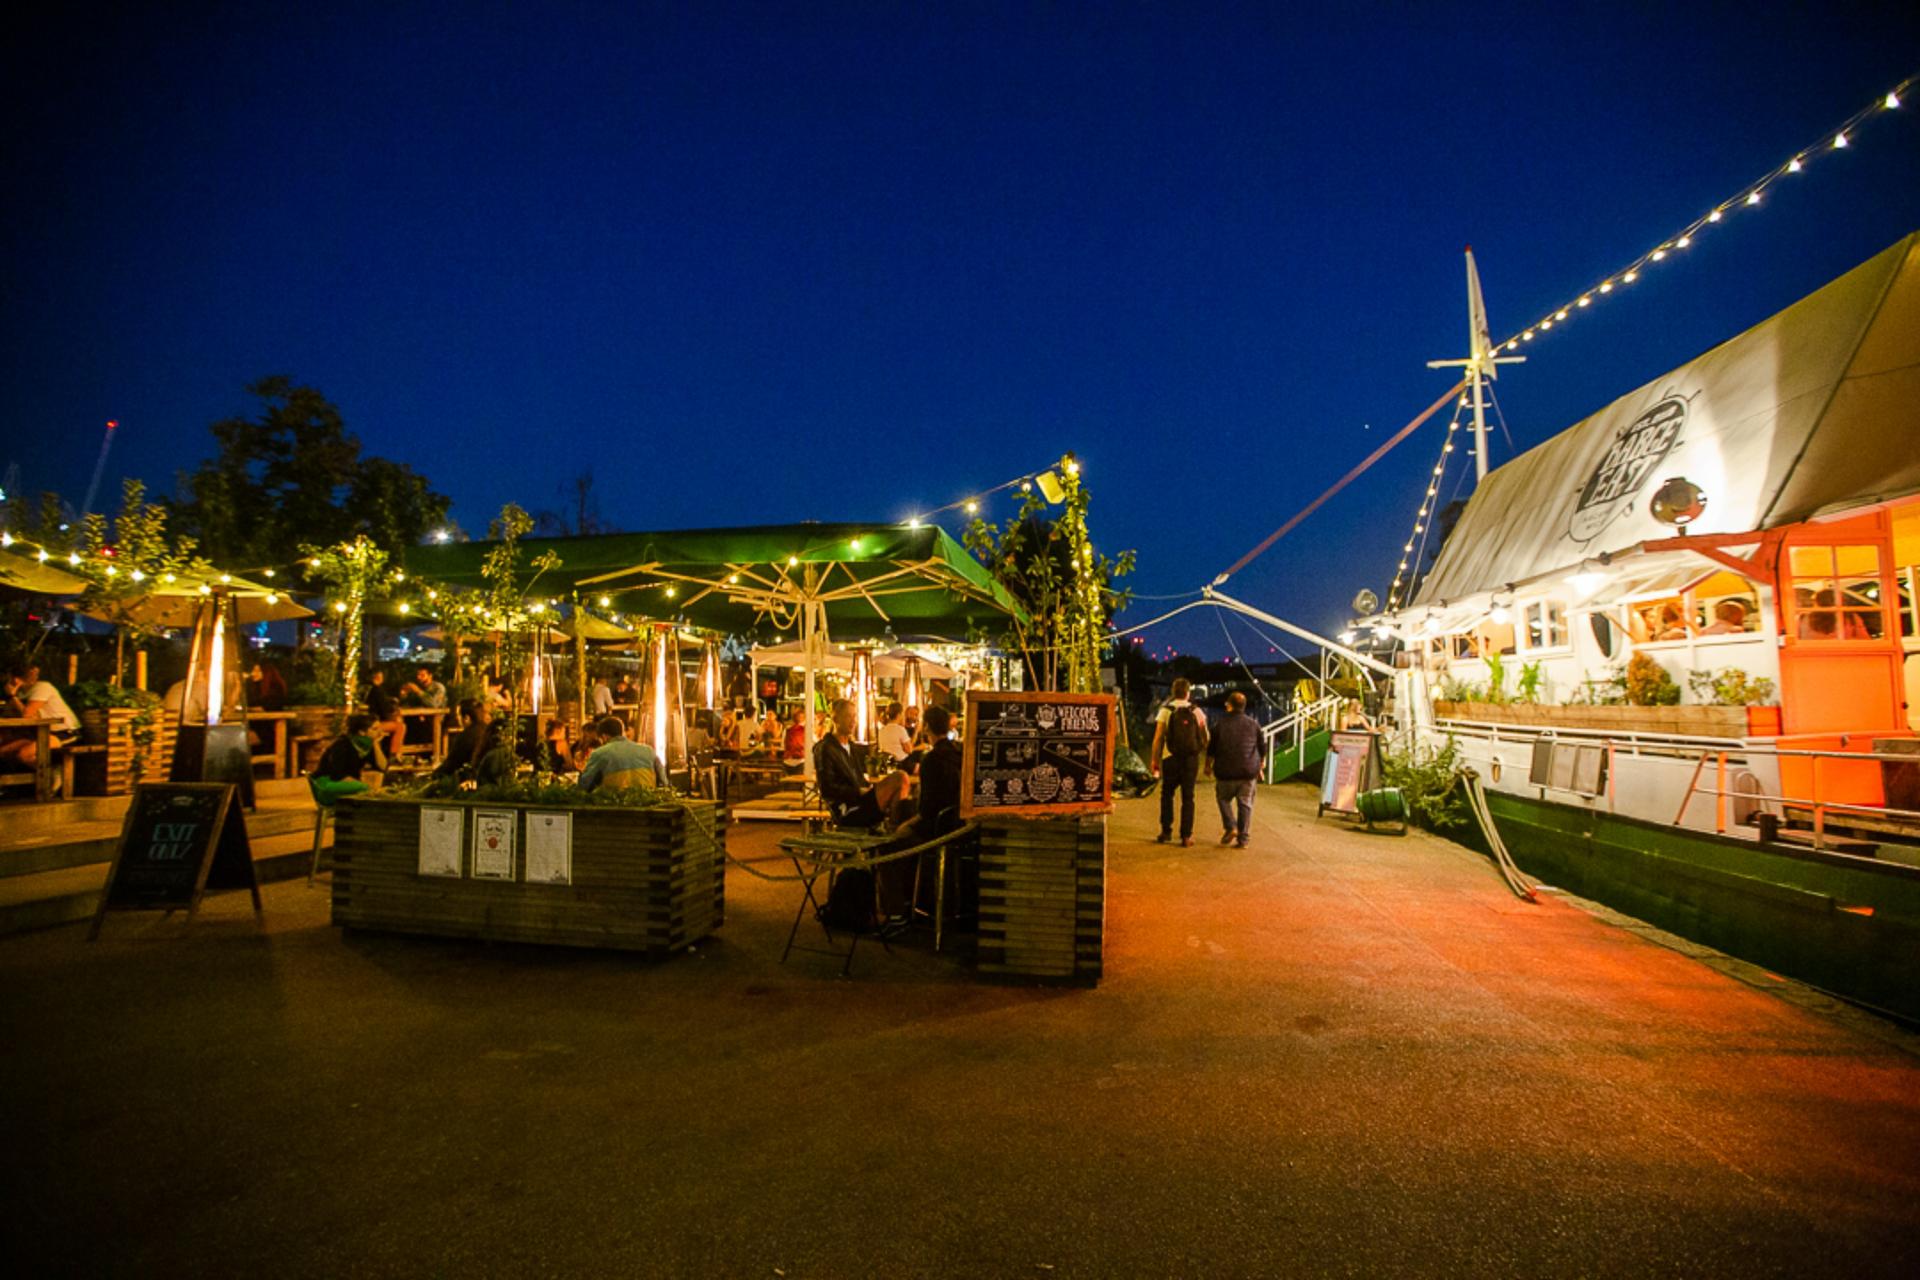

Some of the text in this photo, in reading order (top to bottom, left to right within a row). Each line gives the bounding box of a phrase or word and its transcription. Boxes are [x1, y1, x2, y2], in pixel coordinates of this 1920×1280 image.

[1591, 455, 1661, 502] EAST
[1057, 705, 1098, 719] WELCOME
[1061, 717, 1100, 732] FRIENDS
[152, 823, 197, 841] EXIT
